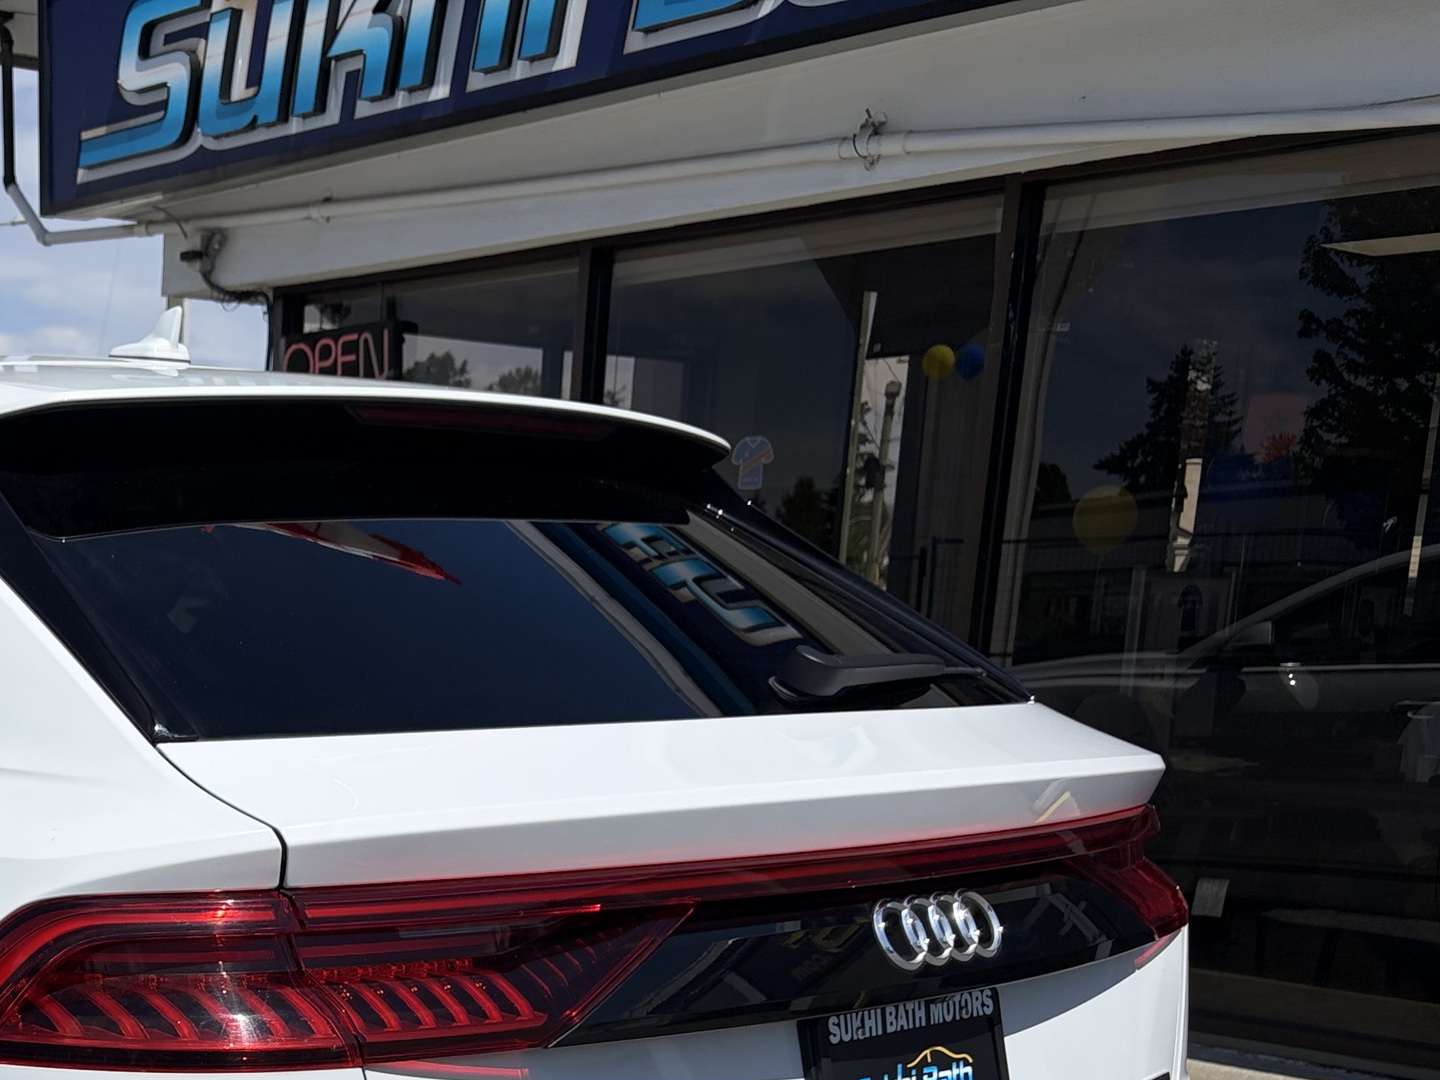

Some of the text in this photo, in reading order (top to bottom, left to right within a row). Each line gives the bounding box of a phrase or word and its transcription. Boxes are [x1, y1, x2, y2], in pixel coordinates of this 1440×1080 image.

[283, 328, 389, 380] OPEN
[828, 988, 994, 1044] SUKHI BATH MOTORS
